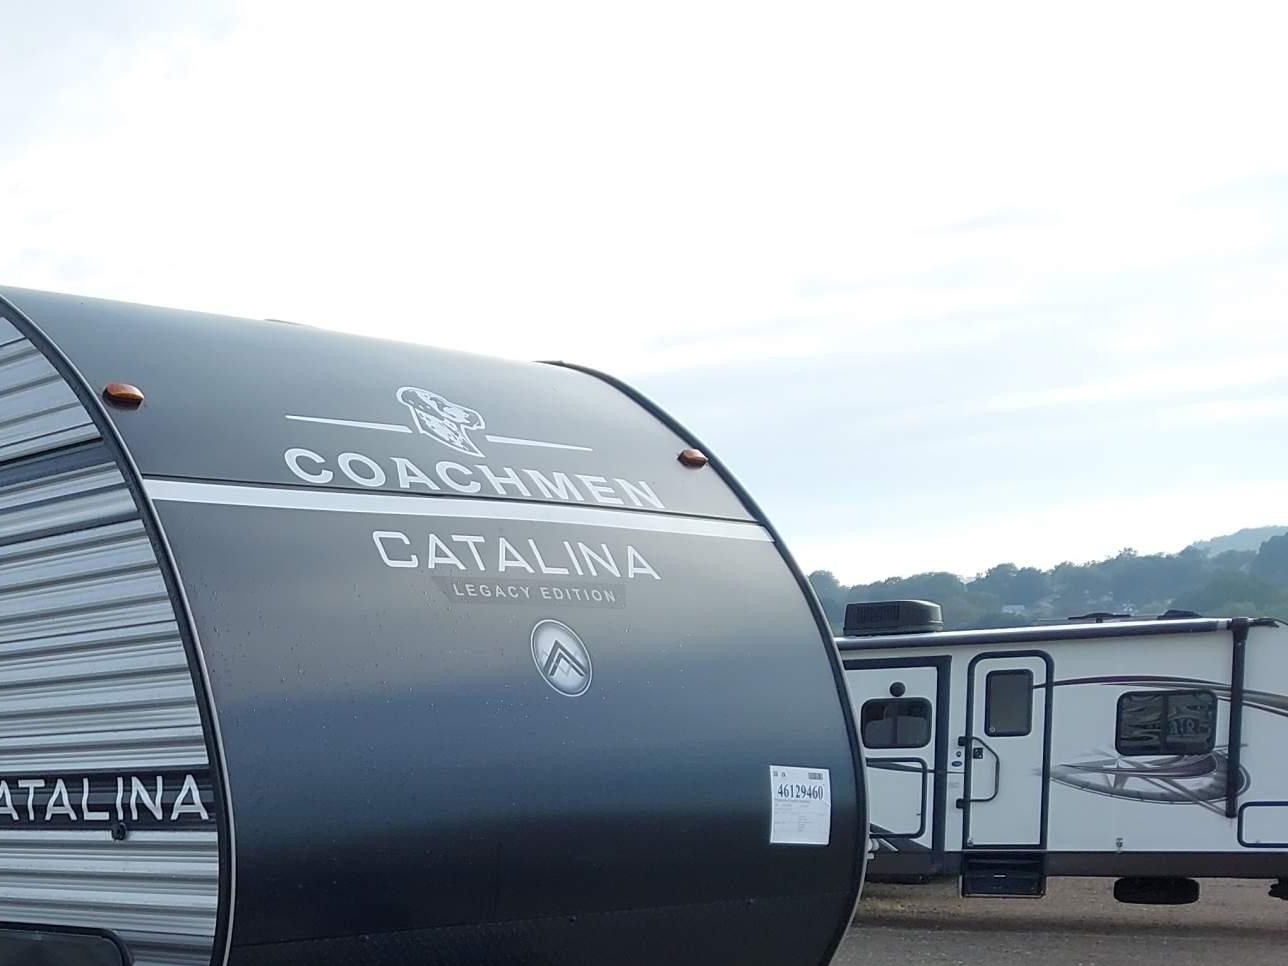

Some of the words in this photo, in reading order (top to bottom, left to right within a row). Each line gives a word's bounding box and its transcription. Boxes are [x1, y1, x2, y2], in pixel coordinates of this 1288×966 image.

[283, 447, 665, 509] COACHMEN
[372, 530, 662, 581] CATALINA
[452, 583, 532, 600] LEGACY
[542, 587, 617, 603] EDITION
[777, 783, 824, 800] 46129460
